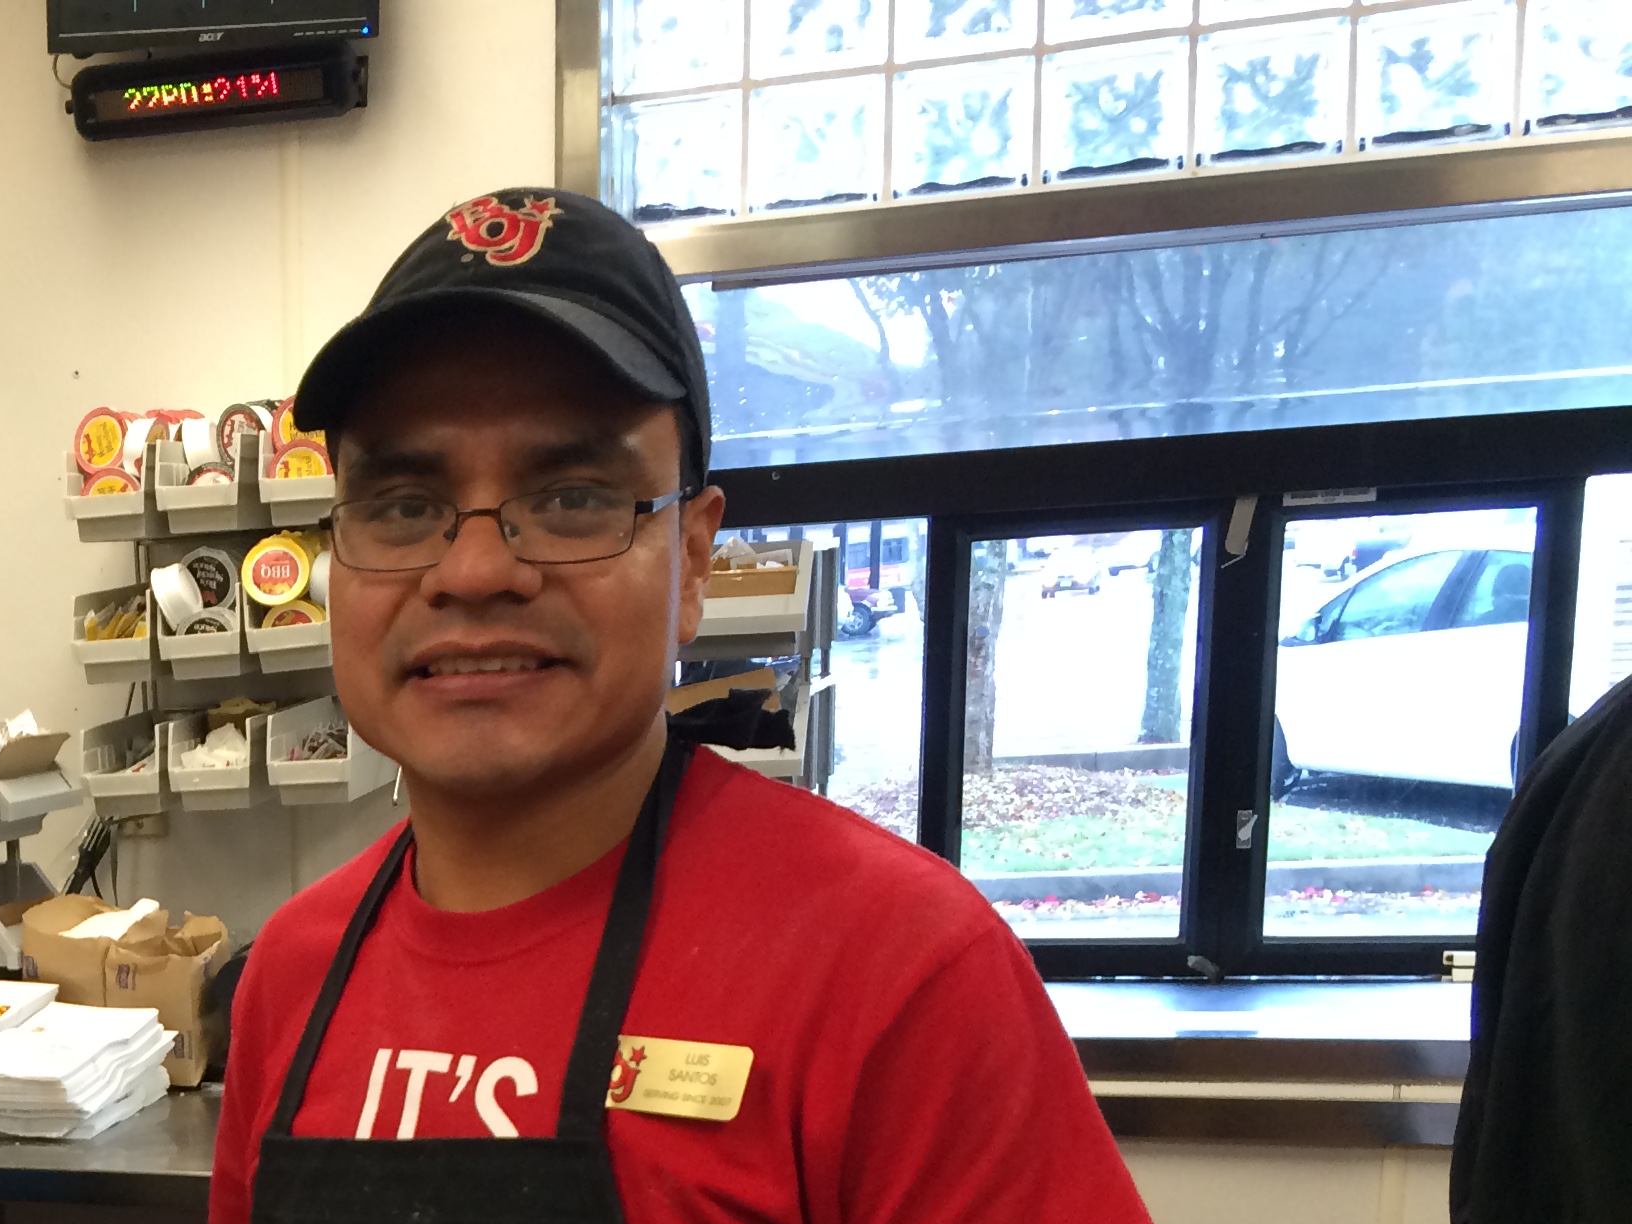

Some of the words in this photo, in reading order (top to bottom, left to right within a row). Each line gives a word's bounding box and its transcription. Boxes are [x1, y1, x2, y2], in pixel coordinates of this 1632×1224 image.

[198, 31, 224, 42] acer
[260, 564, 291, 579] BBQ
[685, 1053, 711, 1067] LUIS
[668, 1068, 718, 1087] SANTOS
[681, 1092, 708, 1105] SINCE
